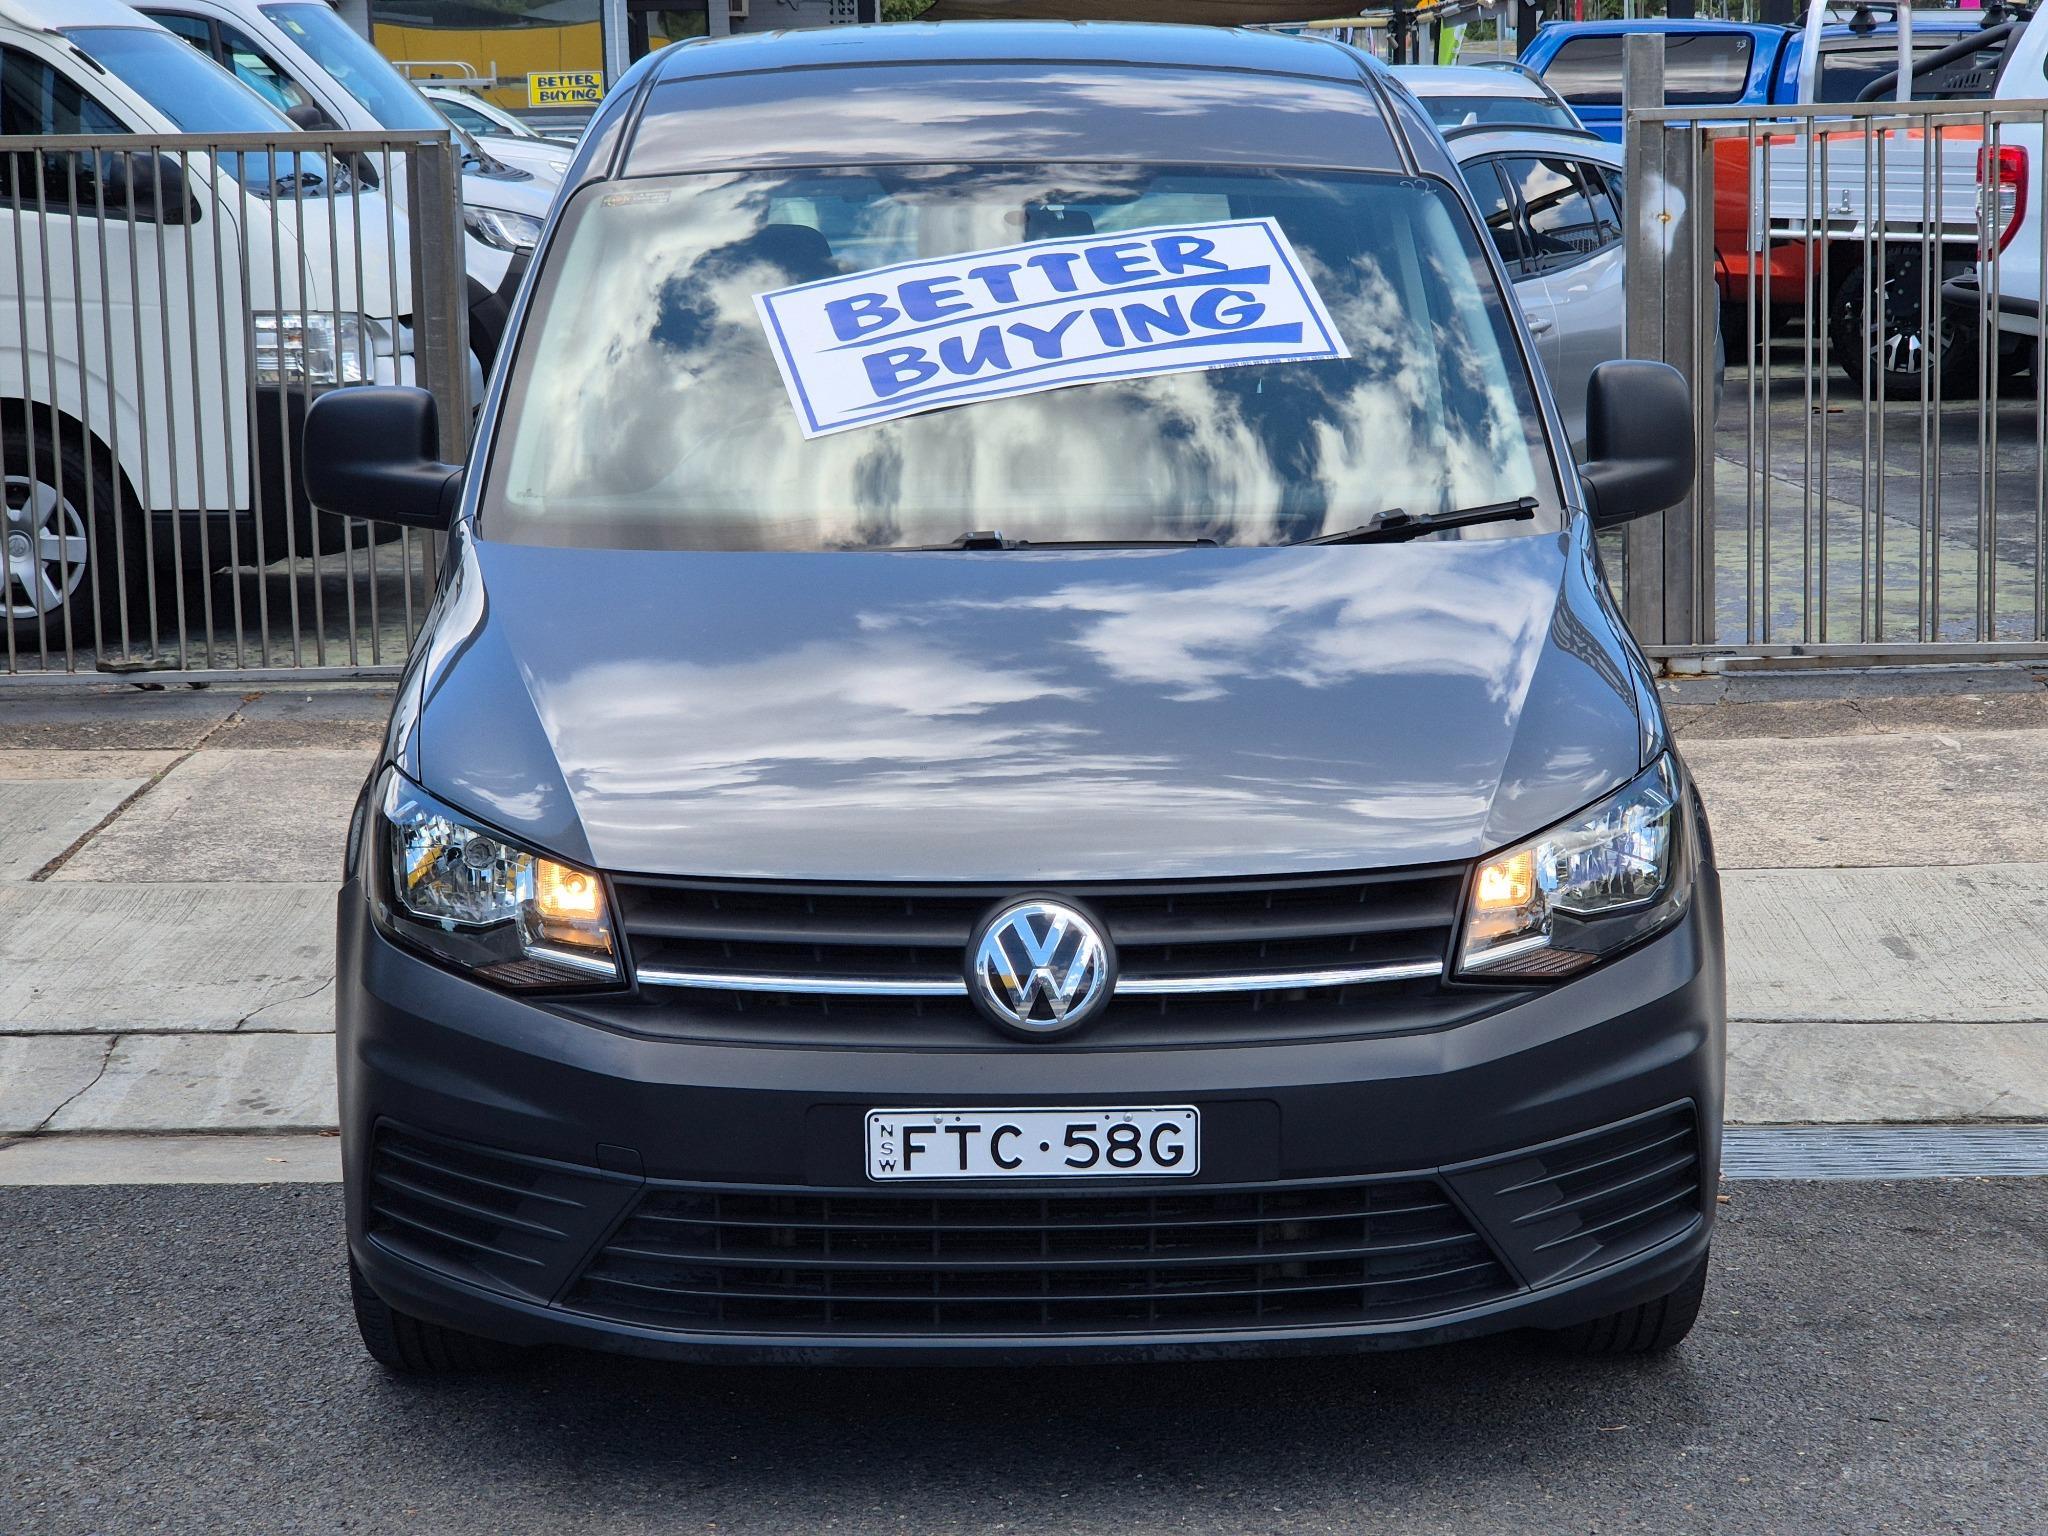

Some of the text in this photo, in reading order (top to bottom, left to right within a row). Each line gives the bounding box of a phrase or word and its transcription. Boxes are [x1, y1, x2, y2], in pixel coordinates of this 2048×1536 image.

[537, 74, 594, 87] BETTER
[540, 88, 597, 101] BUYING
[824, 235, 1229, 341] BETTER
[862, 288, 1266, 398] BUYING
[879, 1124, 897, 1172] NSW
